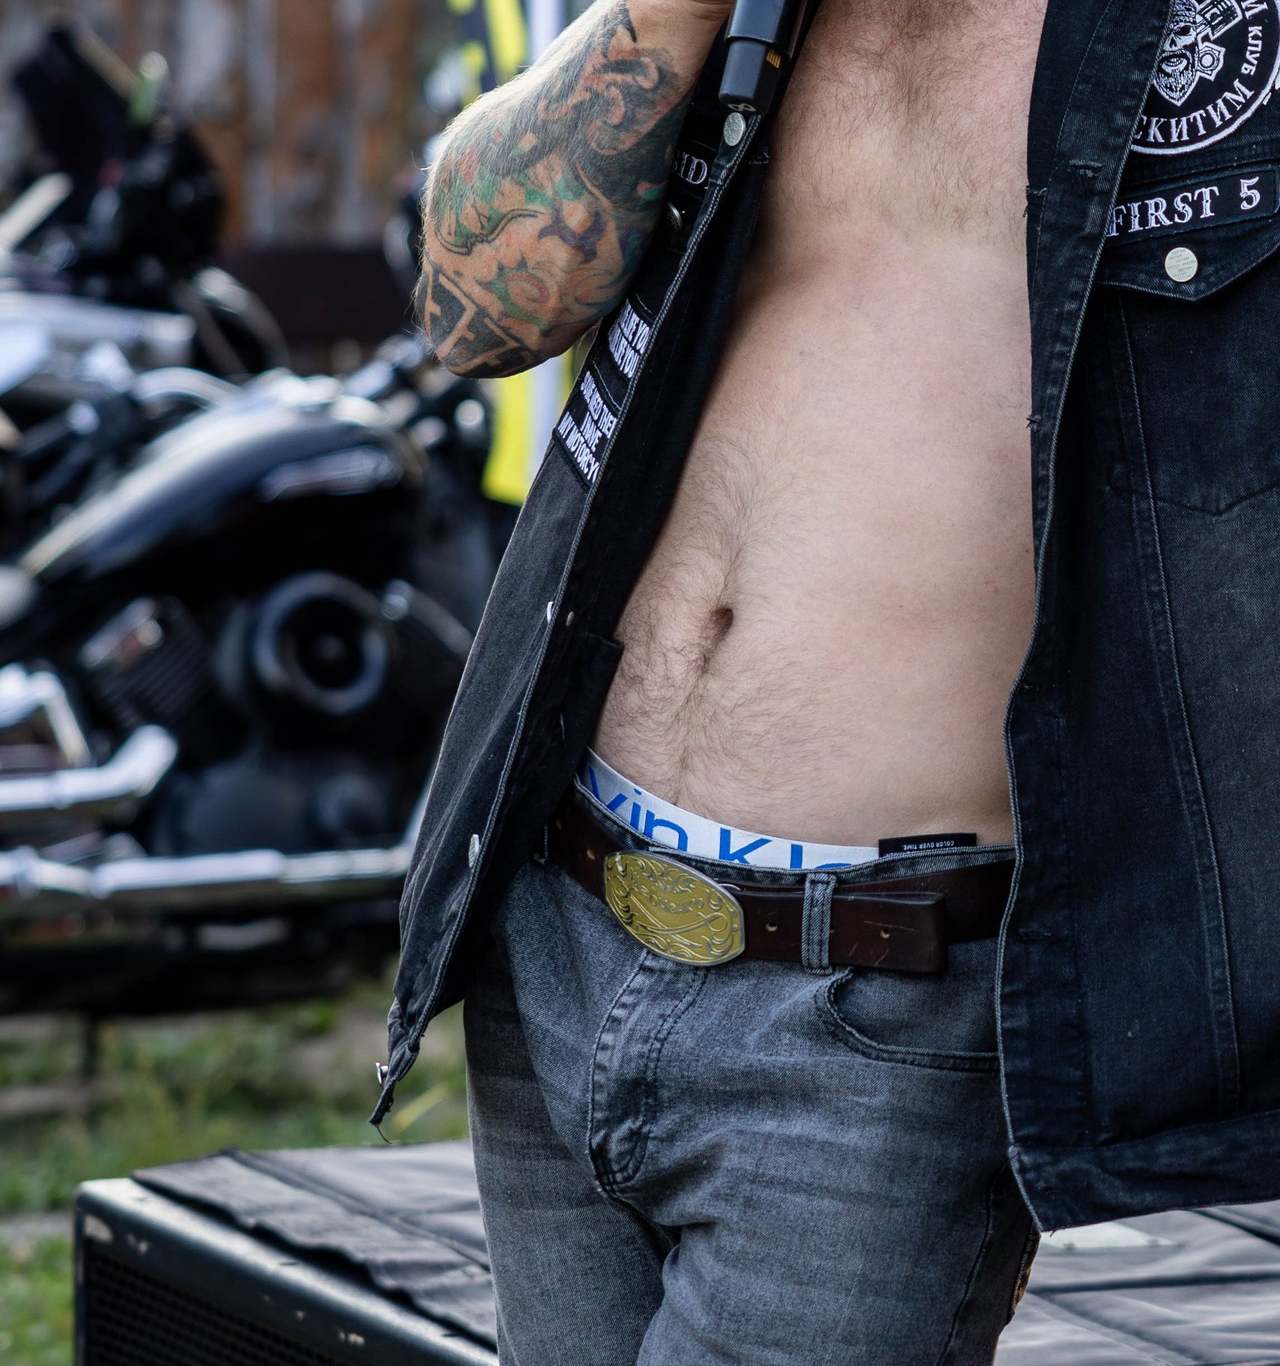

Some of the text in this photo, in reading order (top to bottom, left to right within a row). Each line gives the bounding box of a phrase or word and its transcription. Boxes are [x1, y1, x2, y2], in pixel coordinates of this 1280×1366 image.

[1241, 25, 1263, 76] КЛУБ
[1106, 176, 1261, 237] FIRST 5
[718, 827, 852, 870] Kl
[936, 840, 955, 848] COLOR
